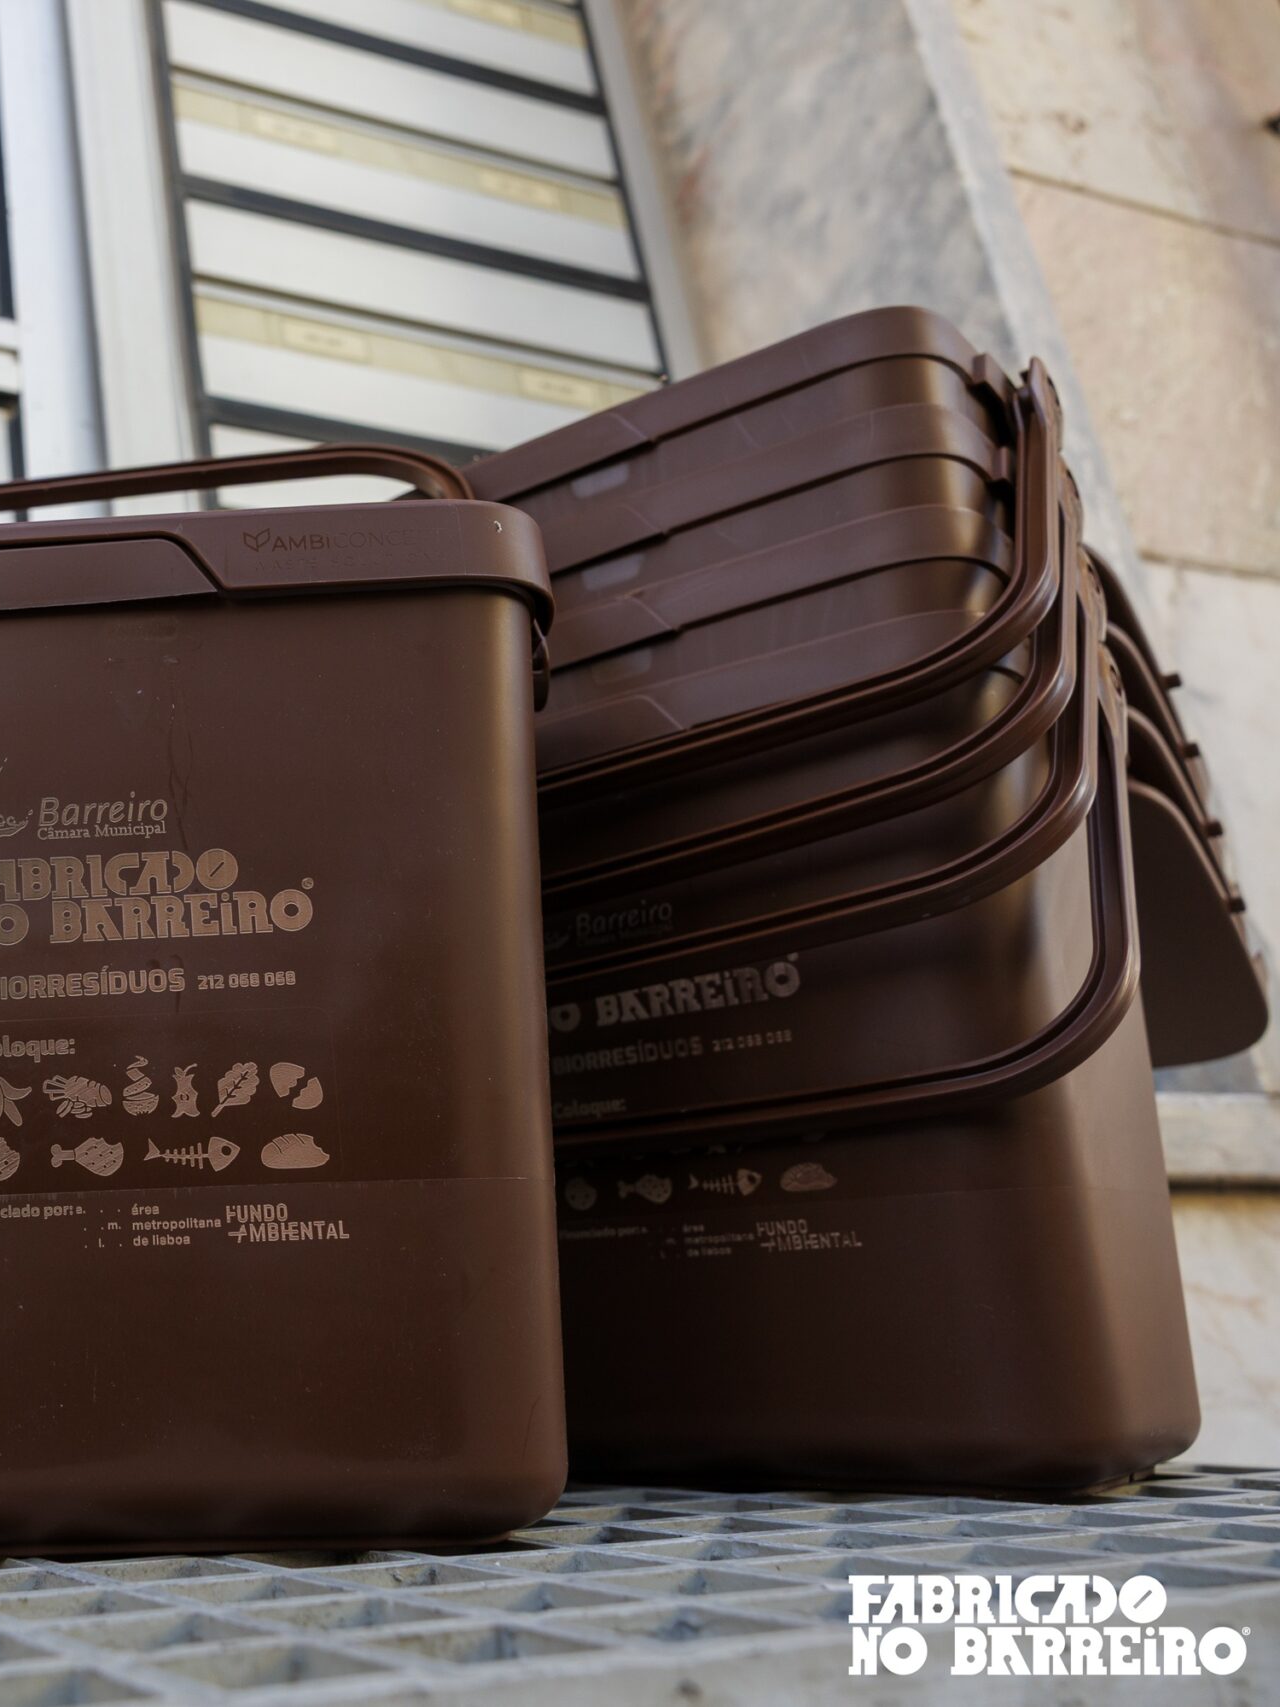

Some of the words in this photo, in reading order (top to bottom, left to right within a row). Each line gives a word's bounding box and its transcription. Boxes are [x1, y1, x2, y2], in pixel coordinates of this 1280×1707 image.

[38, 791, 168, 825] Barreiro
[37, 824, 90, 841] Câmara
[94, 820, 167, 839] Municipal
[576, 899, 673, 936] Barreiro
[197, 974, 224, 990] 212
[229, 973, 259, 988] 068
[264, 971, 297, 986] 068
[552, 1035, 704, 1076] BIORRESÍDUOS
[43, 1204, 74, 1219] por:
[131, 1203, 160, 1216] área
[225, 1203, 288, 1224] FUNDO
[132, 1217, 222, 1232] metropolitana
[755, 1218, 808, 1237] FUNDO
[133, 1235, 149, 1247] de
[152, 1234, 191, 1246] lisboa
